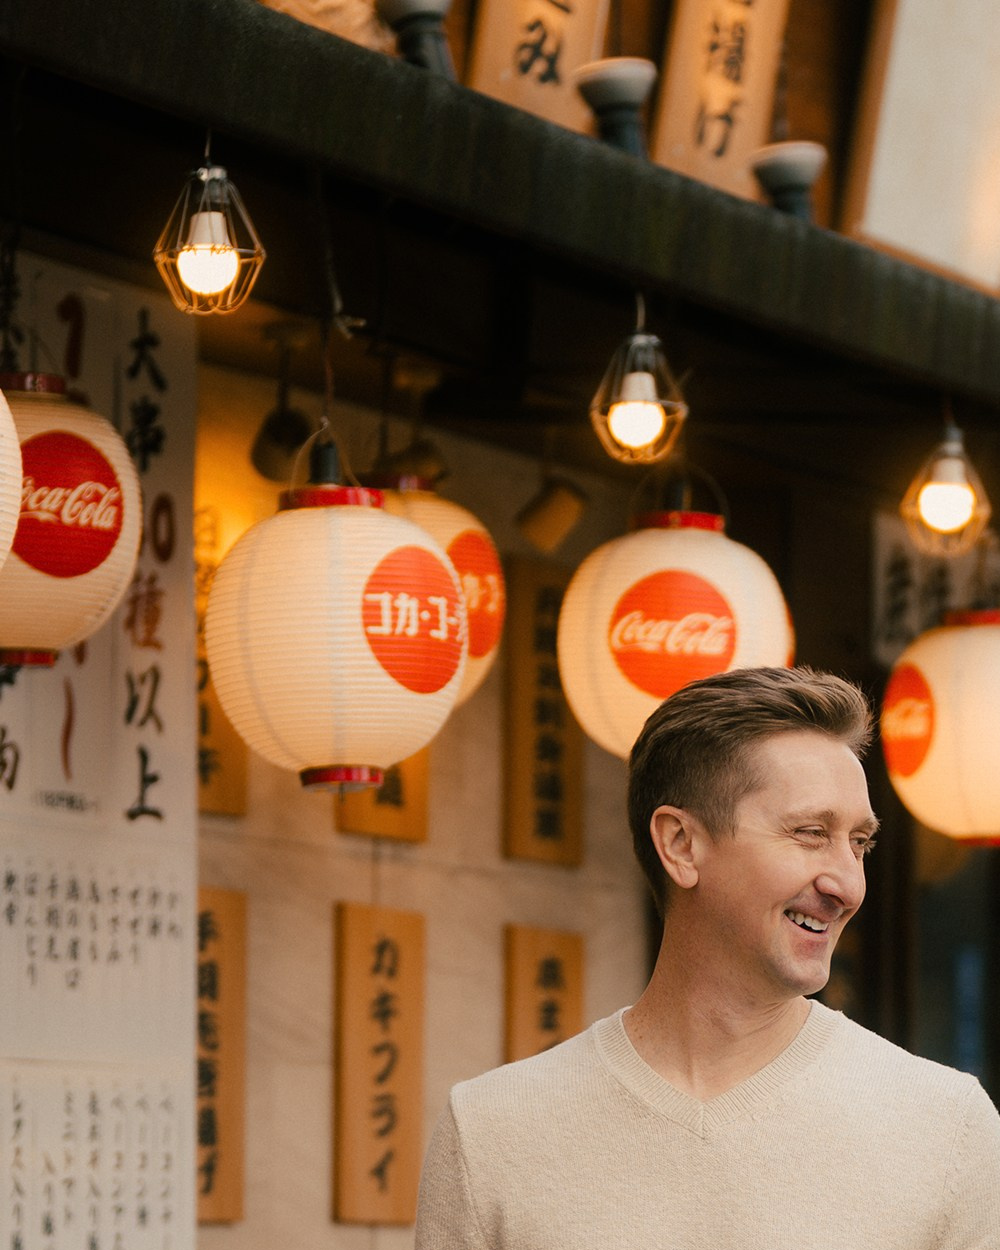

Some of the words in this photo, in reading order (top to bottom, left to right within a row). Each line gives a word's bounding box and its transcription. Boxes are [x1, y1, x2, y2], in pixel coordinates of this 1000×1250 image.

[611, 610, 733, 656] Coca-Cola
[369, 935, 401, 1196] カキフライ
